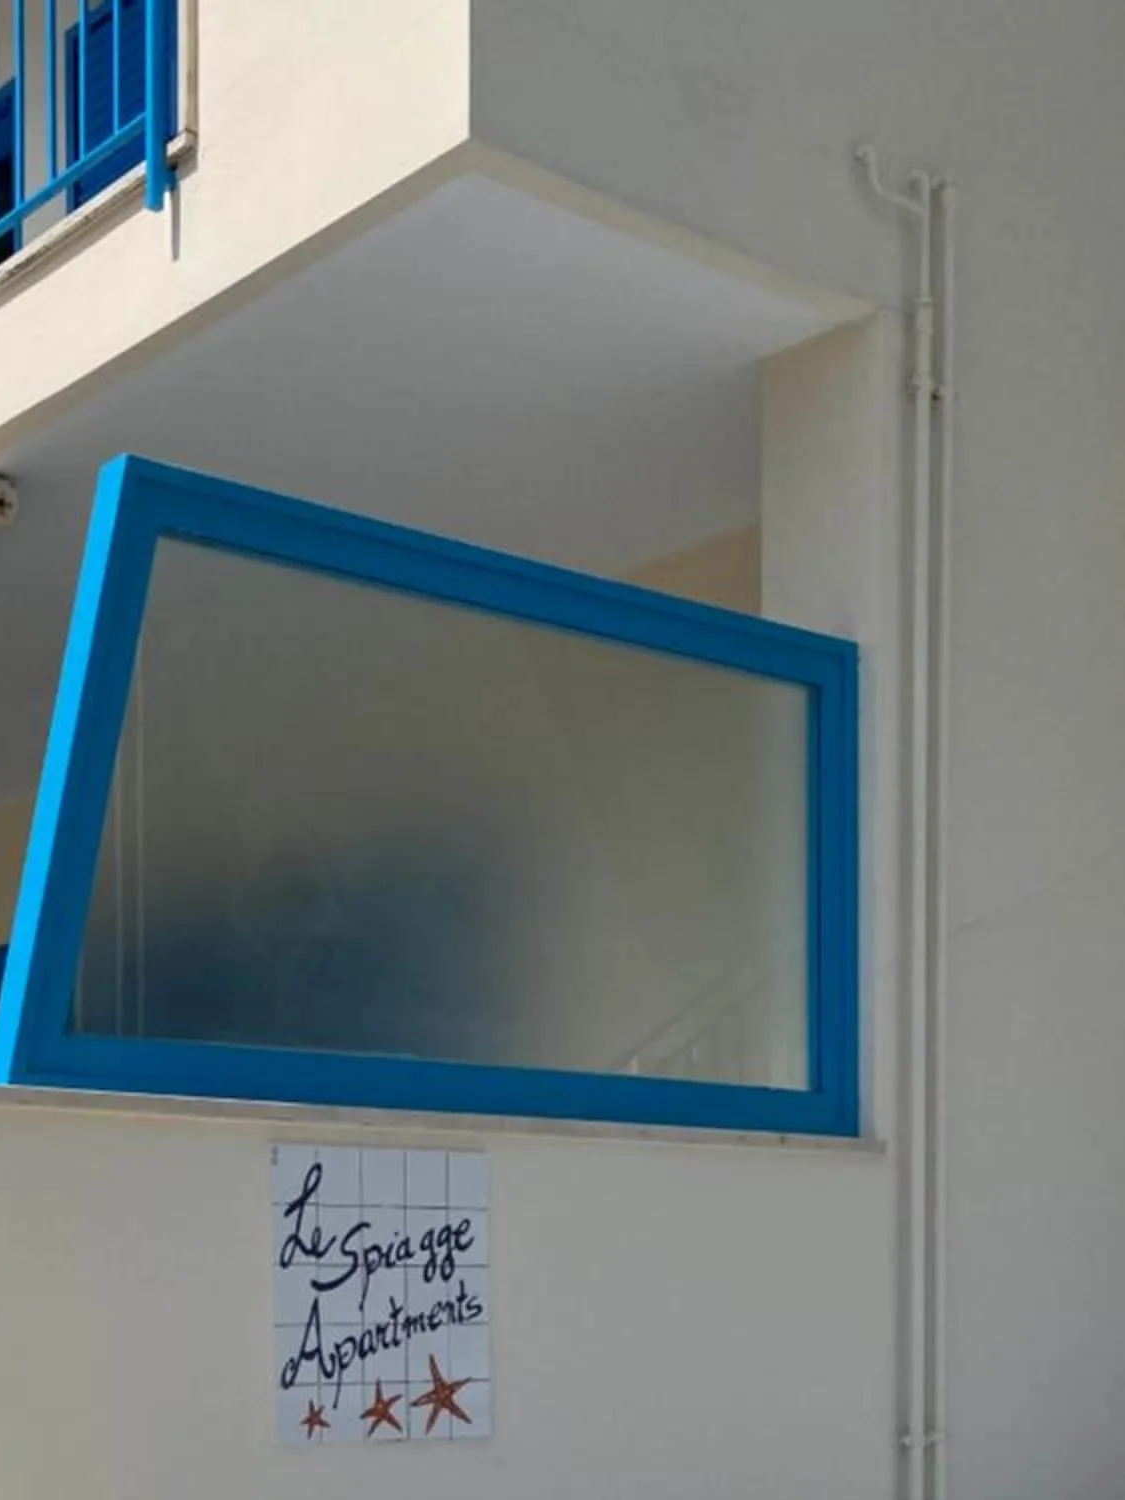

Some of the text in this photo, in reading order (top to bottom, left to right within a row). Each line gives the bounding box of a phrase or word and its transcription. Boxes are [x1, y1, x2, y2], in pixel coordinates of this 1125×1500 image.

[280, 1162, 476, 1312] Le Spiagge
[280, 1279, 484, 1410] Apartments
